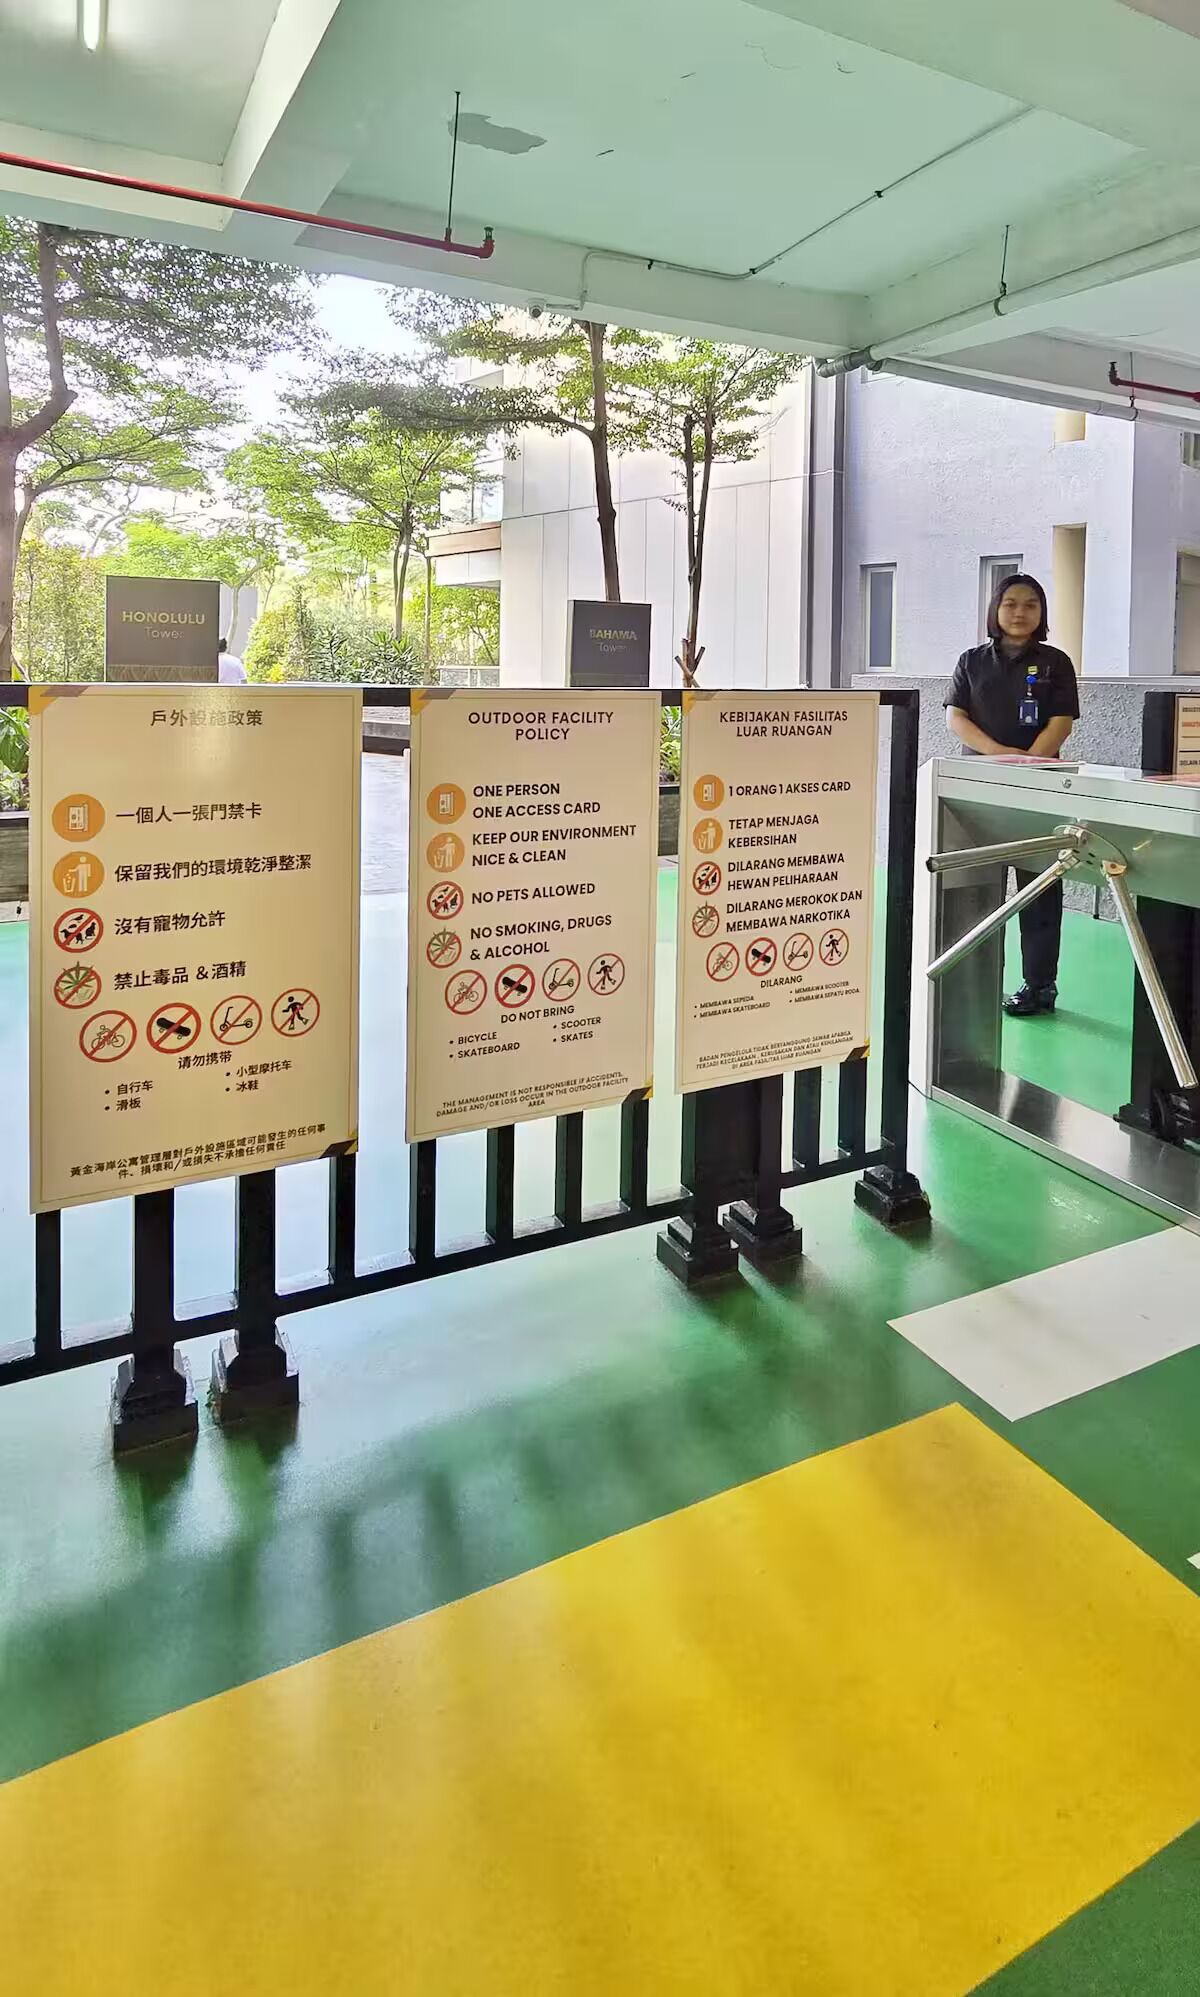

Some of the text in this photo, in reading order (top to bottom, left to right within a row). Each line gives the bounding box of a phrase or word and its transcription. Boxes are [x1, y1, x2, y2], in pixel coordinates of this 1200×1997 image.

[122, 610, 206, 625] HONOLULU
[144, 626, 185, 639] Tower
[590, 628, 638, 640] BAHAMA
[150, 708, 263, 727] 戶外設施政策
[468, 711, 614, 725] OUTDOOR FACILITY
[720, 710, 848, 723] KEBIJAKAN FASILITAS
[515, 728, 570, 741] POLICY
[736, 724, 832, 737] LUAR RUANGAN
[473, 783, 560, 797] ONE PERSON
[729, 781, 851, 796] 1 ORANG 1 AKSES CARD
[116, 802, 262, 824] 一個人一張門禁卡
[472, 802, 600, 819] ONE ACCESS CARD
[729, 814, 819, 830] TETAP MENJAGA
[472, 825, 636, 846] KEEP OUR ENVIRONMENT
[728, 833, 797, 849] KEBERSIHAN
[472, 849, 566, 867] NICE & CLEAN
[728, 853, 845, 873] DILARANG MEMBAWA
[115, 853, 311, 883] 保留我們的環境乾淨整潔
[727, 871, 838, 891] HEWAN PELIHARAAN
[471, 883, 595, 904] NO PETS ALLOWED
[726, 890, 863, 914] DILARANG MEROKOK DAN
[115, 911, 226, 935] 沒有寵物允許
[470, 914, 612, 940] NO SMOKING, DRUGS
[726, 909, 851, 932] MEMBAWA NARKOTIKA
[470, 941, 550, 961] & ALCOHOL
[114, 966, 189, 990] 禁止毒品
[760, 975, 803, 989] DILARANG
[794, 981, 849, 994] MEMBAWA SCOOTER
[794, 987, 860, 1003] MEMBAWA SEPATU RODA
[699, 995, 754, 1009] MEMBAWA SEPEDA
[699, 1002, 771, 1018] MEMBAWA SKATEBOARD
[500, 1005, 575, 1024] DO NOT BRING
[561, 1016, 601, 1030] SCOOTER
[458, 1031, 497, 1045] BICYCLE
[561, 1030, 593, 1043] SKATES
[457, 1041, 520, 1059] SKATEBOARD
[699, 1054, 719, 1062] BADAN
[178, 1050, 233, 1070] 请勿携带
[236, 1060, 292, 1078] 小型摩托车
[117, 1080, 153, 1096] 自行车
[236, 1080, 259, 1093] 冰鞋
[442, 1100, 456, 1108] THE
[458, 1091, 509, 1106] MANAGEMENT
[518, 1086, 532, 1095] NOT
[534, 1079, 577, 1091] RESPONSIBLE
[116, 1097, 141, 1112] 滑板
[436, 1105, 467, 1117] DAMAGE
[469, 1100, 499, 1111] AND/OR
[501, 1097, 518, 1105] LOSS
[519, 1092, 544, 1102] OCCUR
[555, 1087, 567, 1095] THE
[569, 1082, 600, 1093] OUTDOOR
[602, 1077, 628, 1087] FACILITY
[528, 1099, 545, 1107] AREA
